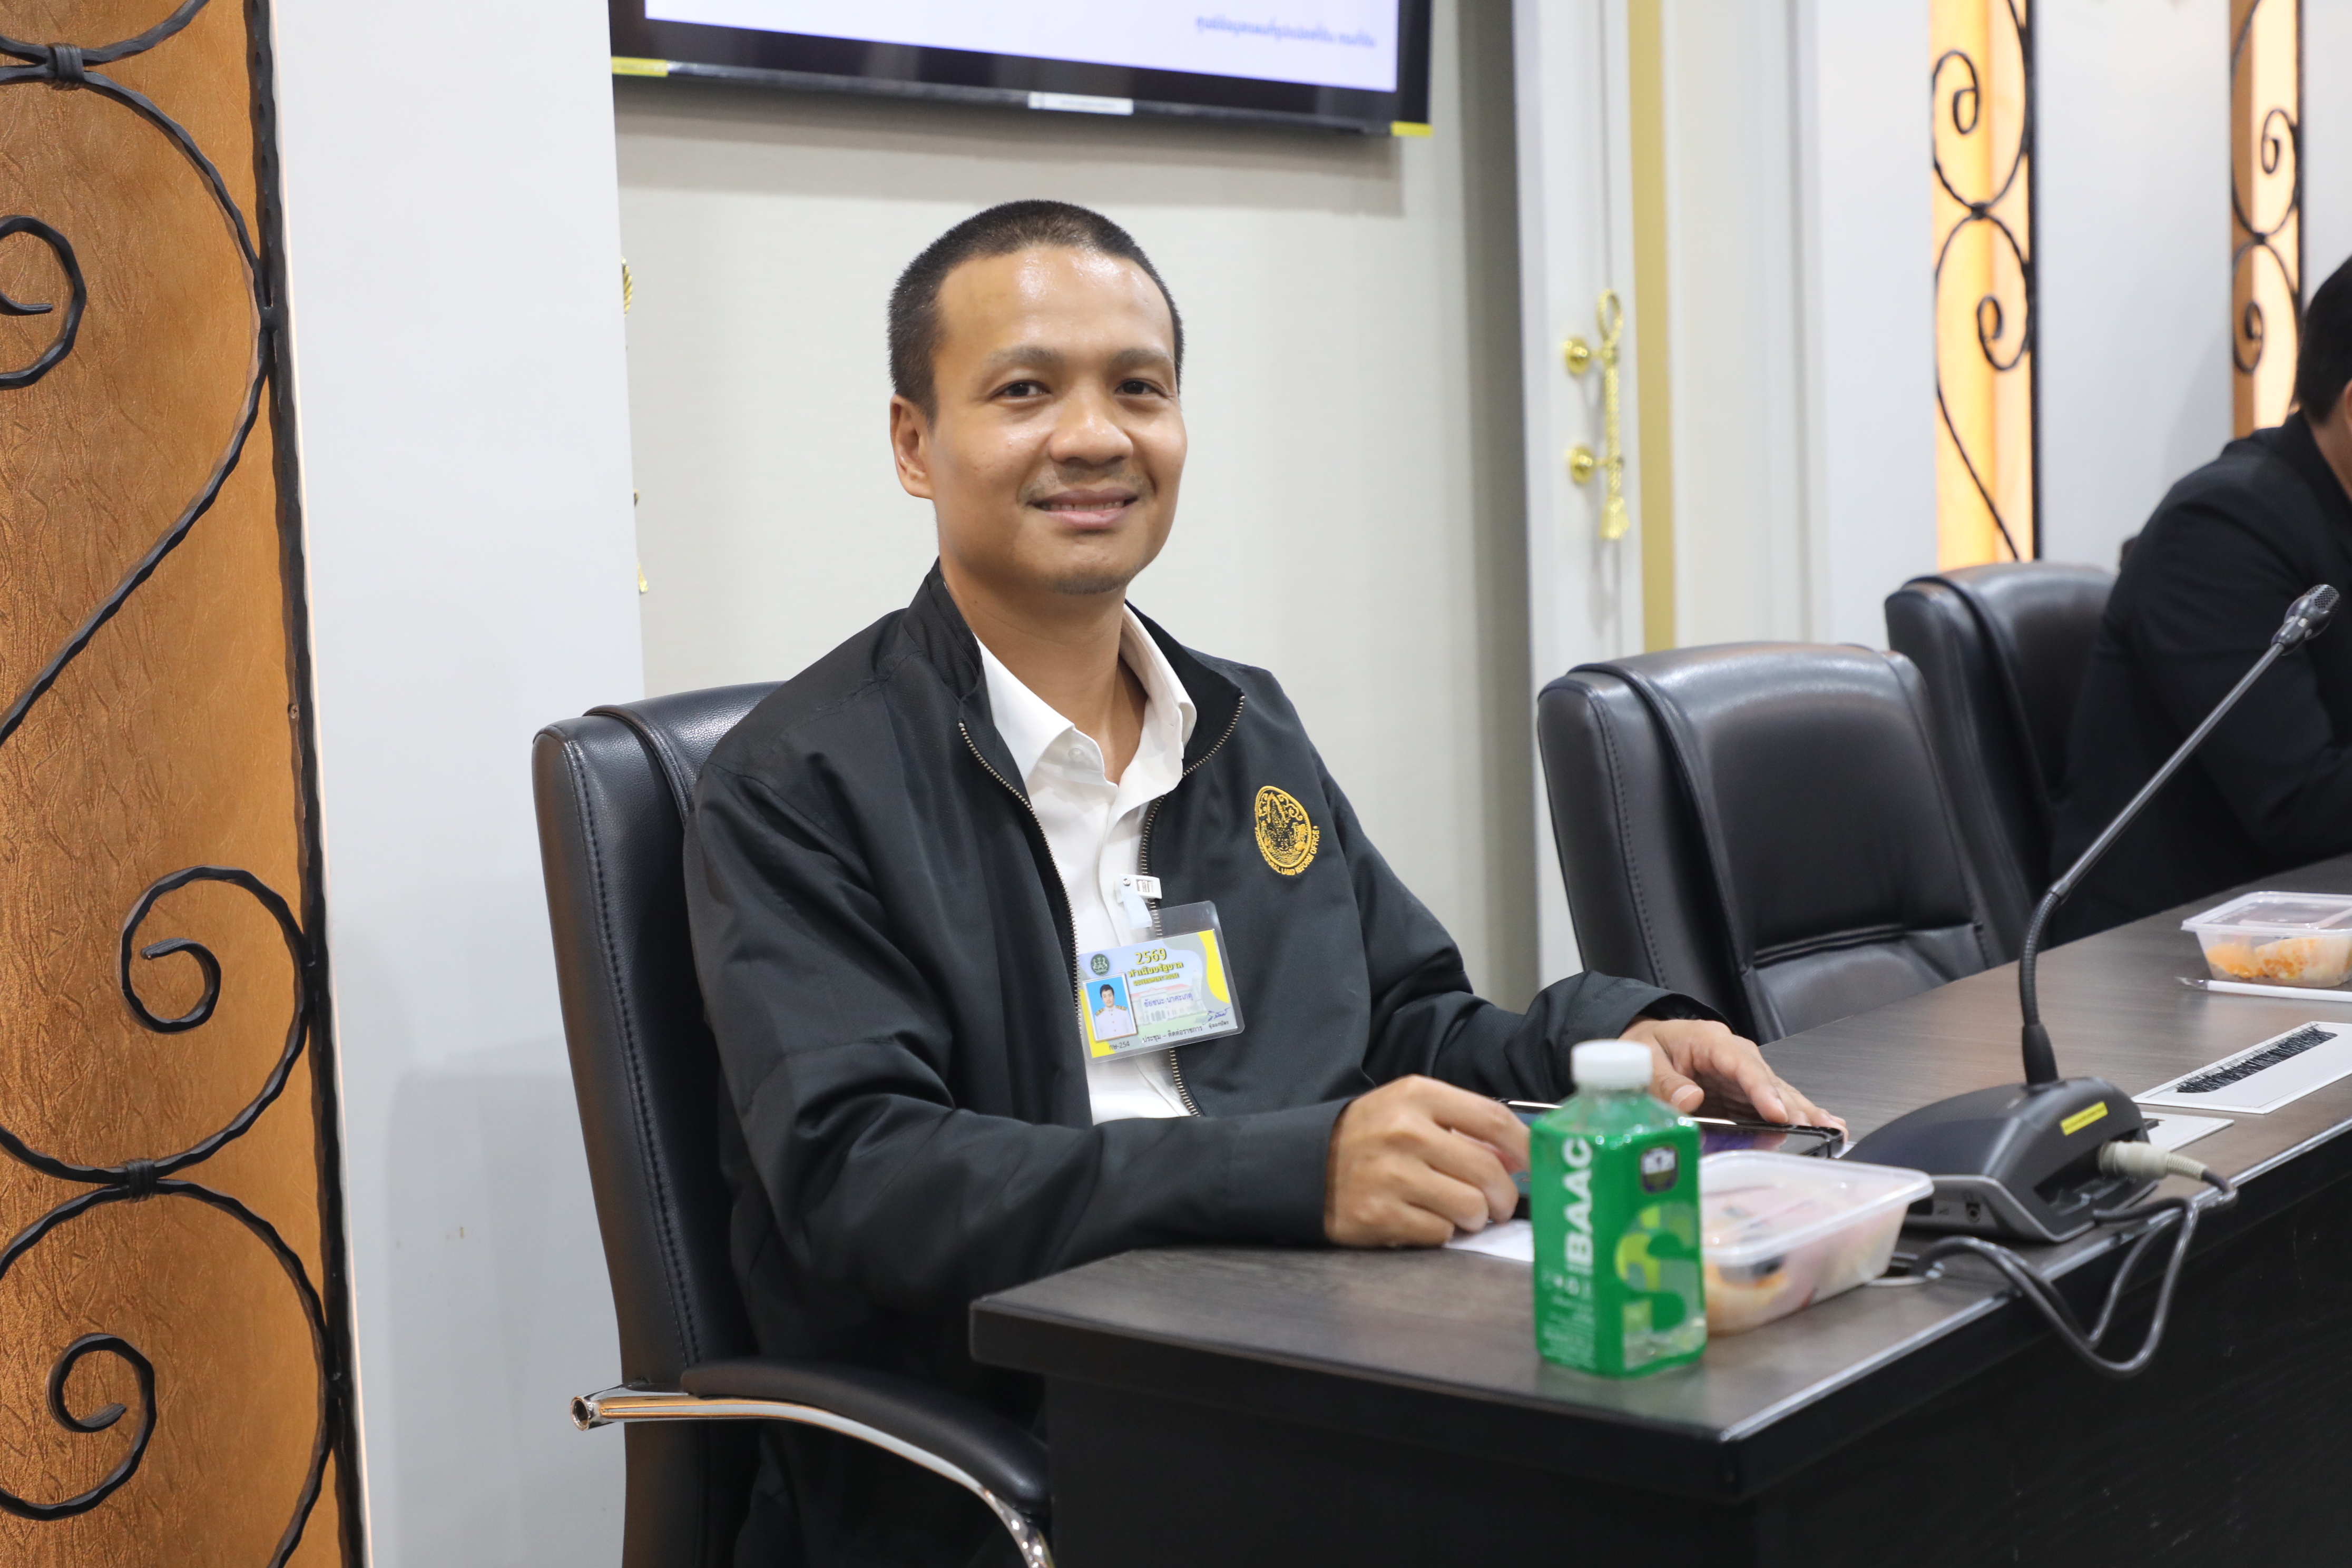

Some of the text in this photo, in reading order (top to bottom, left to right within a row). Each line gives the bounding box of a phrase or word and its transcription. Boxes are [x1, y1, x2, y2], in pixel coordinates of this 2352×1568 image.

[1296, 852, 1315, 874] REFORM
[1310, 830, 1320, 854] OFFICE
[1134, 947, 1167, 965] 2569
[1128, 961, 1183, 978] ทำเนียบรัฐบาล
[1133, 973, 1180, 986] GOVERNMENT HOUSE
[1167, 1025, 1203, 1037] ติดต่อราชการ
[1563, 1138, 1593, 1266] BAAC
